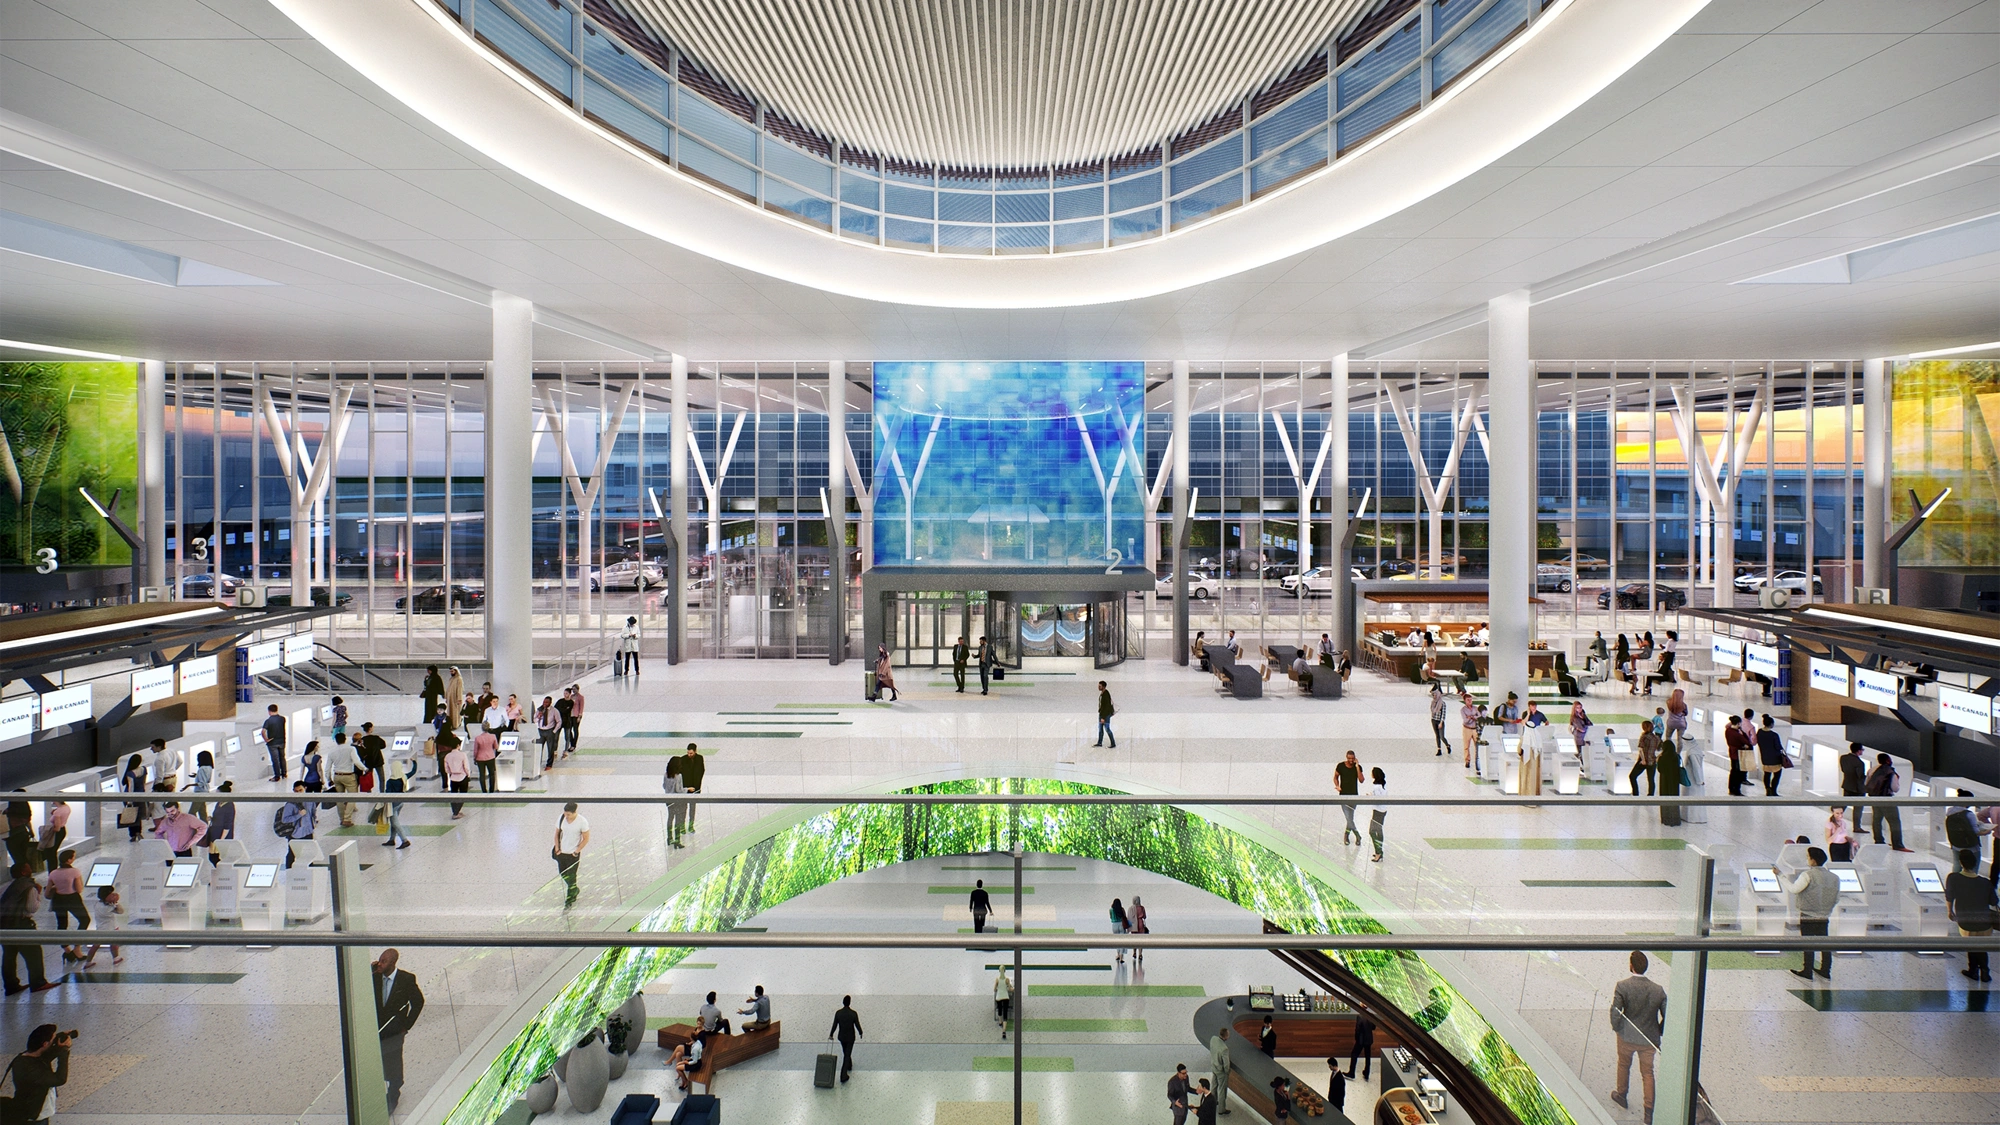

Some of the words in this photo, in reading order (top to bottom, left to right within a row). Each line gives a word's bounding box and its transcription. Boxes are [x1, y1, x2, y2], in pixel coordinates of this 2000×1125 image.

[191, 537, 208, 560] 3
[35, 548, 58, 575] 3
[1105, 548, 1123, 575] 2
[240, 588, 255, 606] D
[1770, 589, 1788, 608] C
[1869, 589, 1885, 604] B
[196, 668, 215, 677] CANADA
[1820, 672, 1847, 684] AEROMEXICO
[150, 679, 171, 688] CANADA
[1866, 683, 1896, 696] AEROMEXICO
[53, 704, 64, 712] AIR
[64, 699, 89, 709] CANADA
[1961, 706, 1988, 718] CANADA
[1, 713, 30, 724] CANADA
